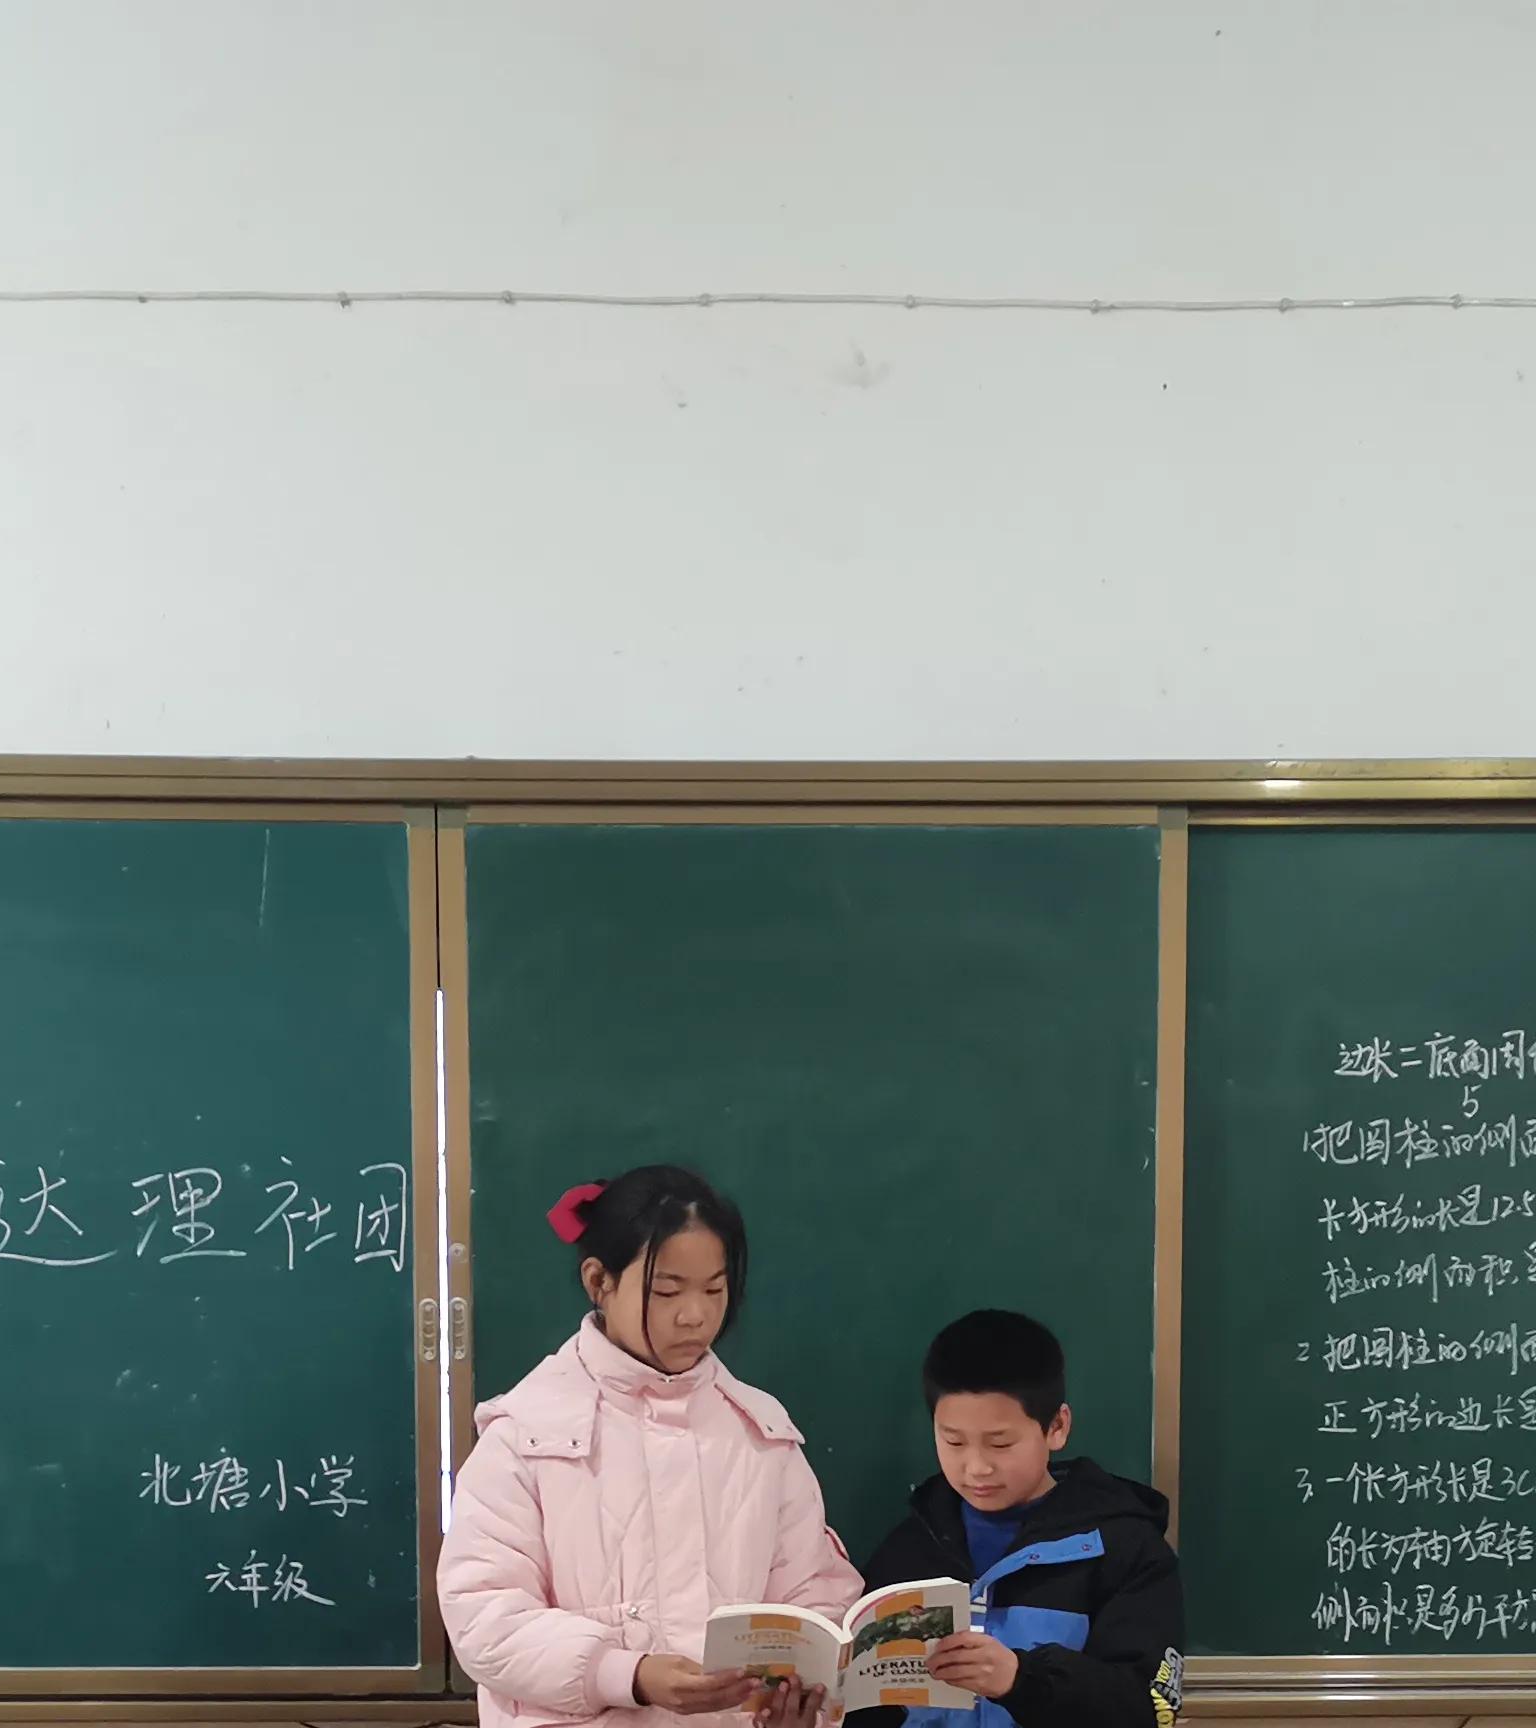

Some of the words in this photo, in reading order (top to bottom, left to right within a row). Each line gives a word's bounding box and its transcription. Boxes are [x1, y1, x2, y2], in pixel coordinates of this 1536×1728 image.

[139, 1446, 368, 1517] 北塘小学
[204, 1549, 335, 1607] 六年级
[858, 1660, 927, 1677] LITERATU
